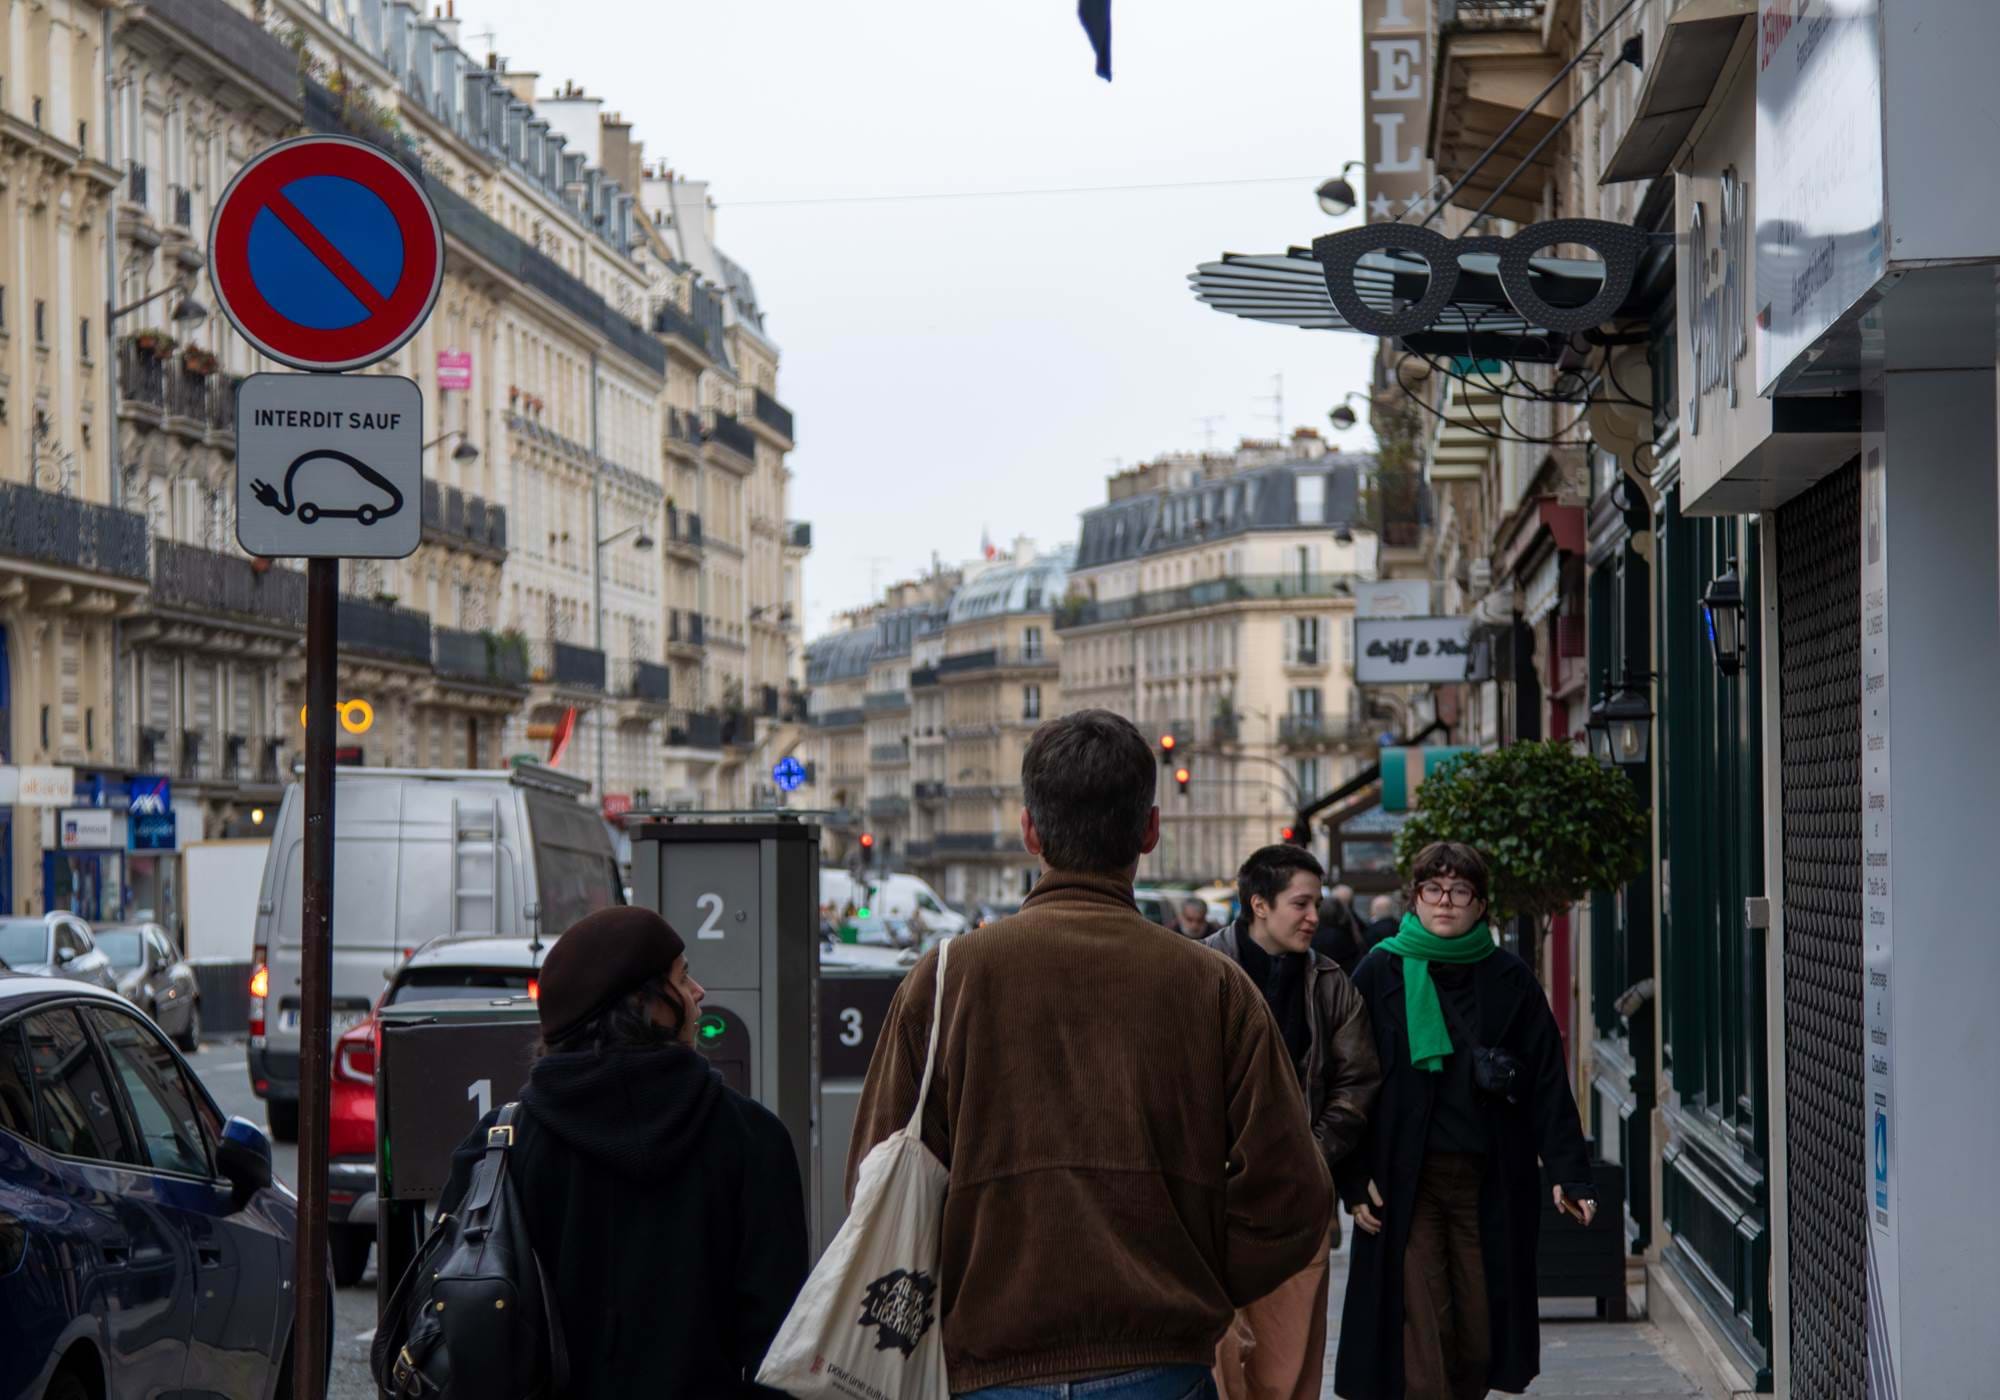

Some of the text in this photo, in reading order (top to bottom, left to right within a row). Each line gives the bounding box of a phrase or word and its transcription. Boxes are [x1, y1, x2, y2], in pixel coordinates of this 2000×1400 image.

[255, 409, 401, 430] INTERDIT SAUF
[129, 793, 166, 814] AXA
[697, 893, 725, 939] 2
[839, 1008, 863, 1046] 3
[467, 1079, 492, 1121] 1
